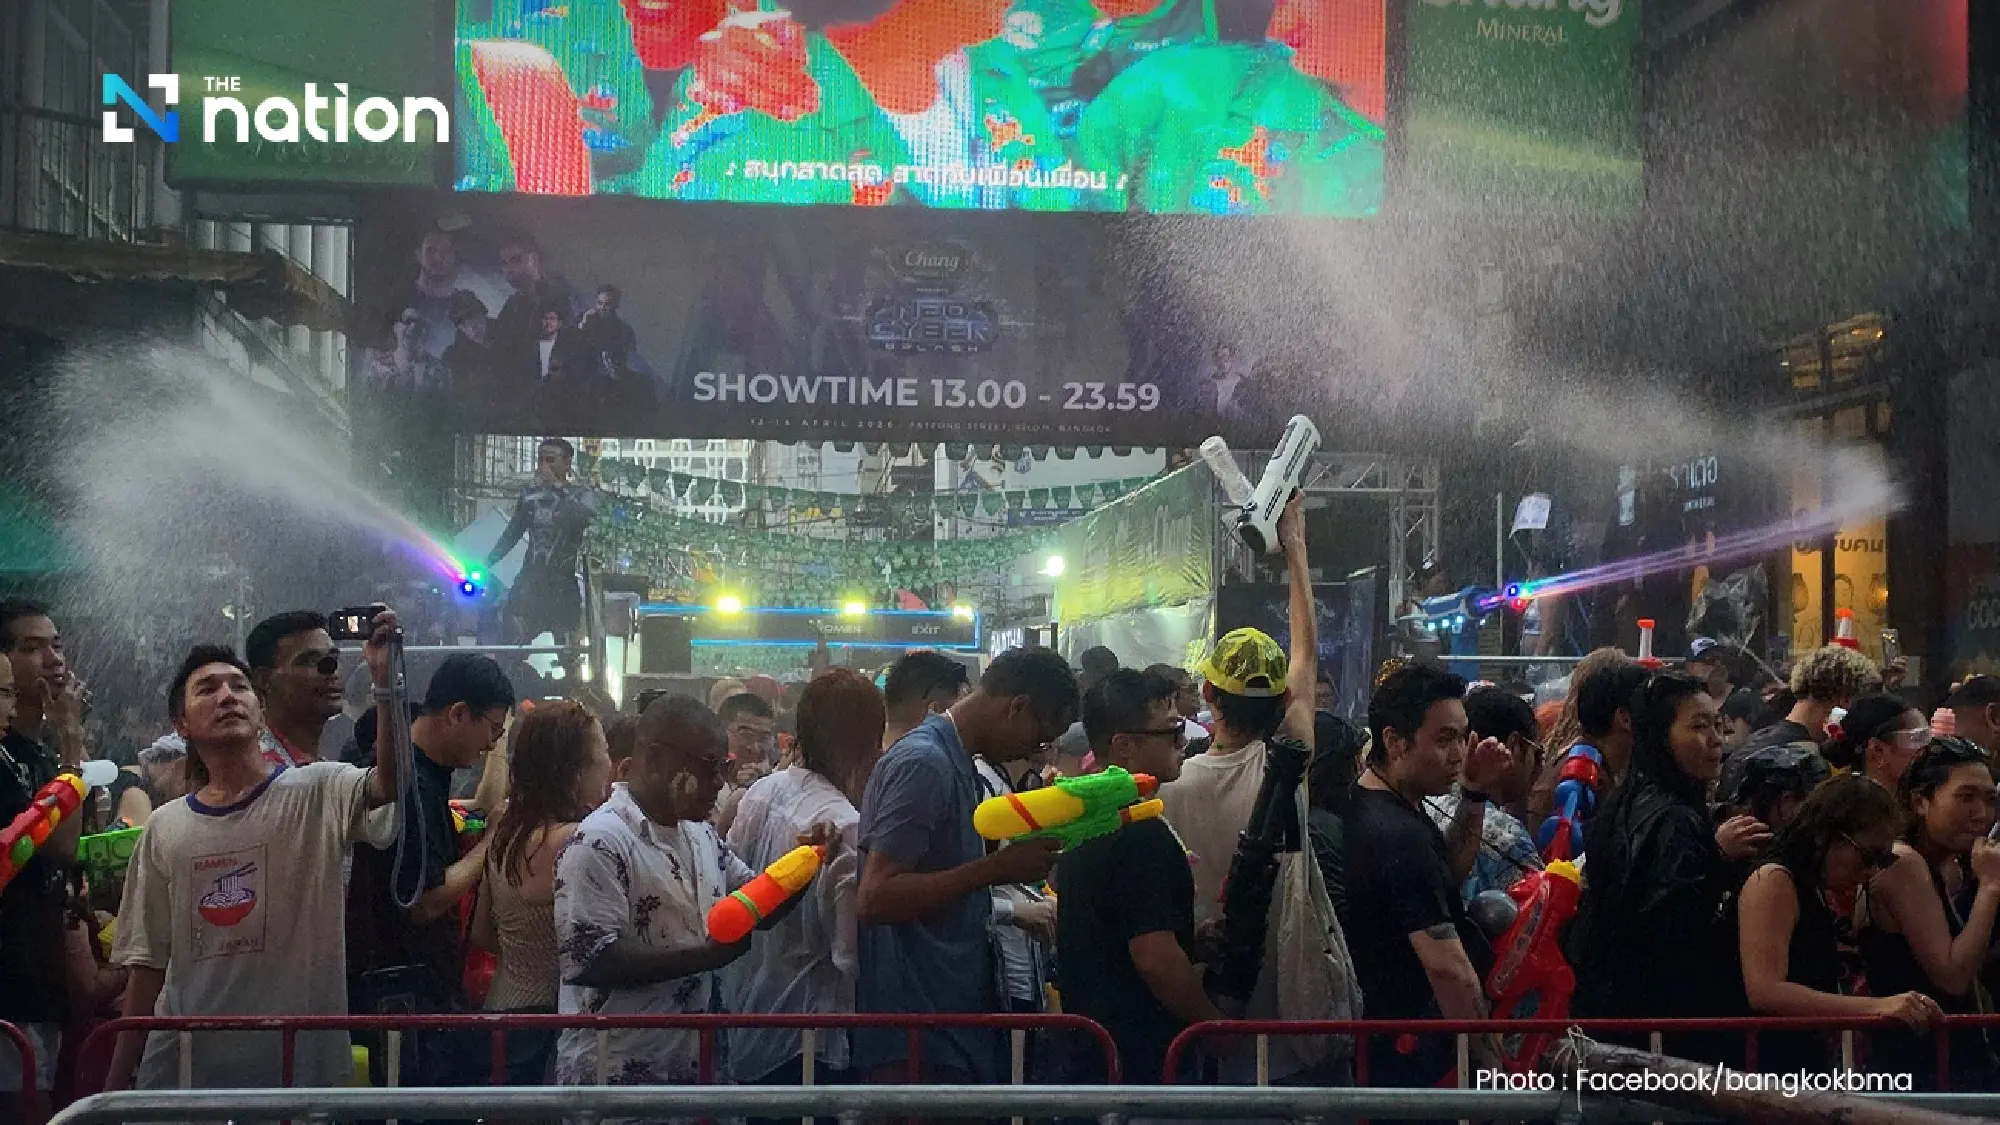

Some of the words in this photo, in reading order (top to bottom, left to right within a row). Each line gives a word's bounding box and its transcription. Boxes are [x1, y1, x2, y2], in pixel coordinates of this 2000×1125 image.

[1476, 17, 1567, 43] MINERAL
[905, 251, 960, 271] Chang
[884, 342, 978, 352] SPLASH
[693, 371, 918, 406] SHOWTIME
[931, 379, 1027, 408] 13.00
[1062, 382, 1160, 411] 23.59
[911, 623, 941, 635] EXIT
